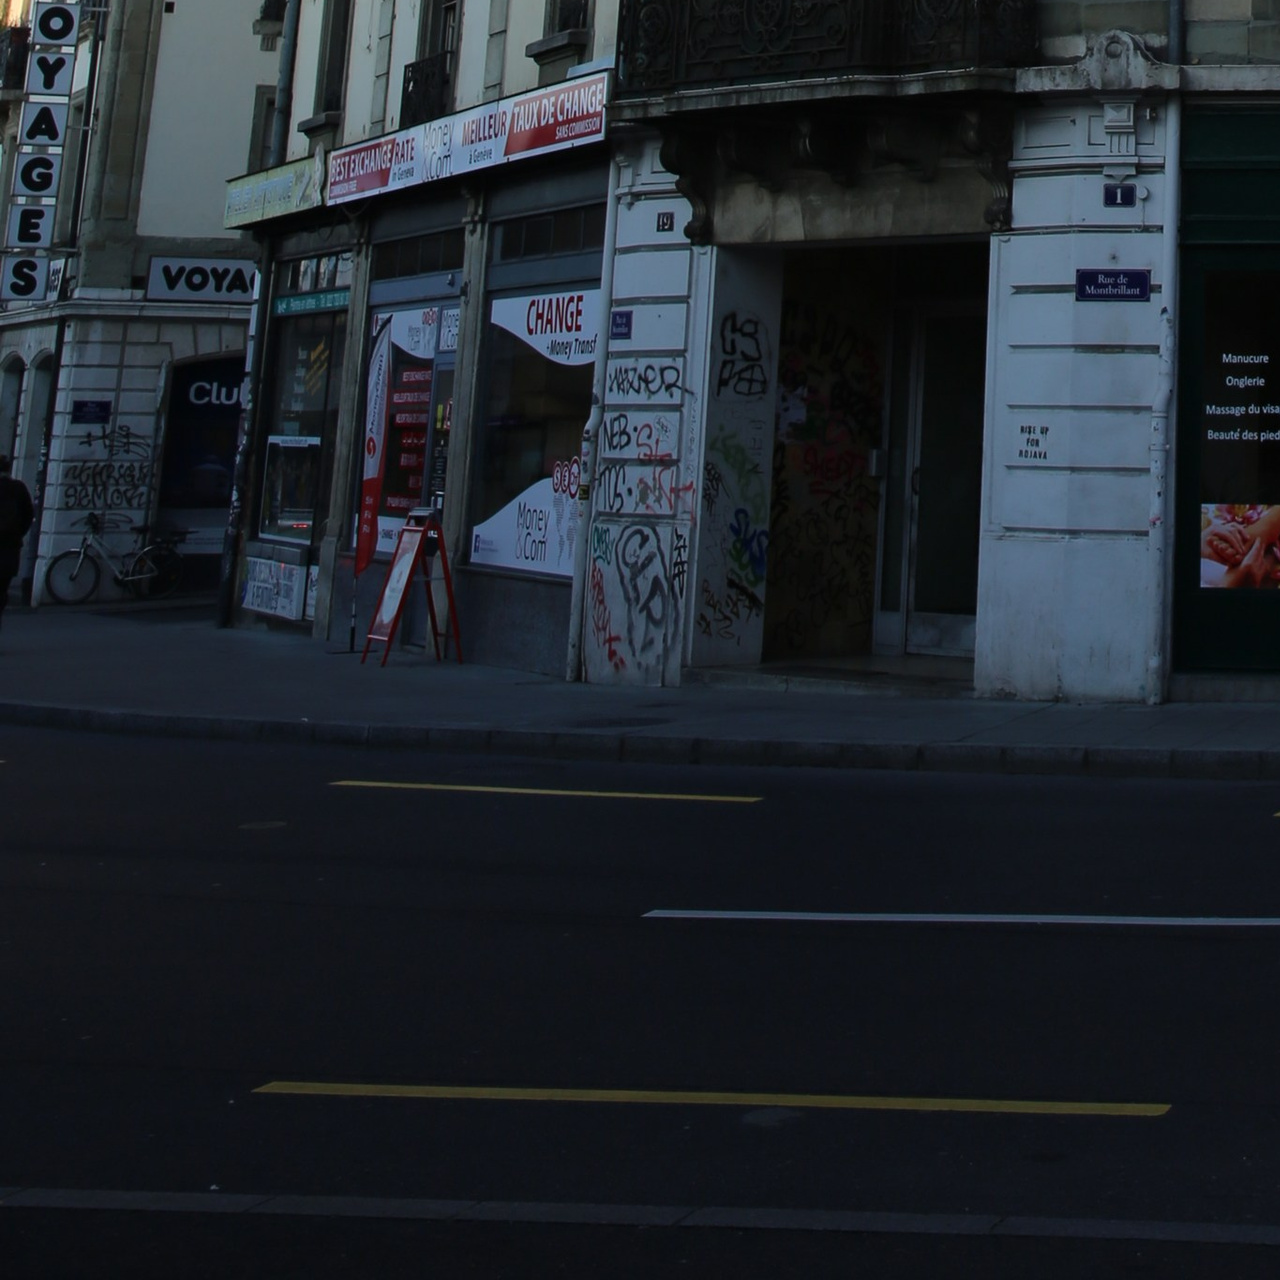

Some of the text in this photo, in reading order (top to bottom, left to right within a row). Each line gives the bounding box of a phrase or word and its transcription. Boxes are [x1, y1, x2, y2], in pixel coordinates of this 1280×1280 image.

[513, 83, 603, 133] TAUX DE CHANGE
[462, 110, 507, 147] MEILLEUR
[555, 115, 600, 139] SANS COMMISSION
[330, 137, 415, 183] BEST EXCHANGE RATE
[397, 166, 414, 181] Geneva
[1115, 187, 1123, 204] 1
[162, 264, 255, 294] VOYA
[1098, 274, 1129, 284] Rue de
[1085, 284, 1140, 295] Montbrillant
[527, 295, 584, 335] CHANGE
[1222, 353, 1269, 363] Manucure
[1226, 376, 1266, 388] Onglerie
[1206, 404, 1246, 416] Massage
[1248, 403, 1261, 414] du
[1020, 425, 1049, 435] RISE UP
[1207, 428, 1240, 440] Beauté
[1242, 429, 1258, 440] des
[1026, 438, 1040, 447] FOR
[1019, 449, 1047, 460] ROJAVA
[516, 502, 551, 539] Money
